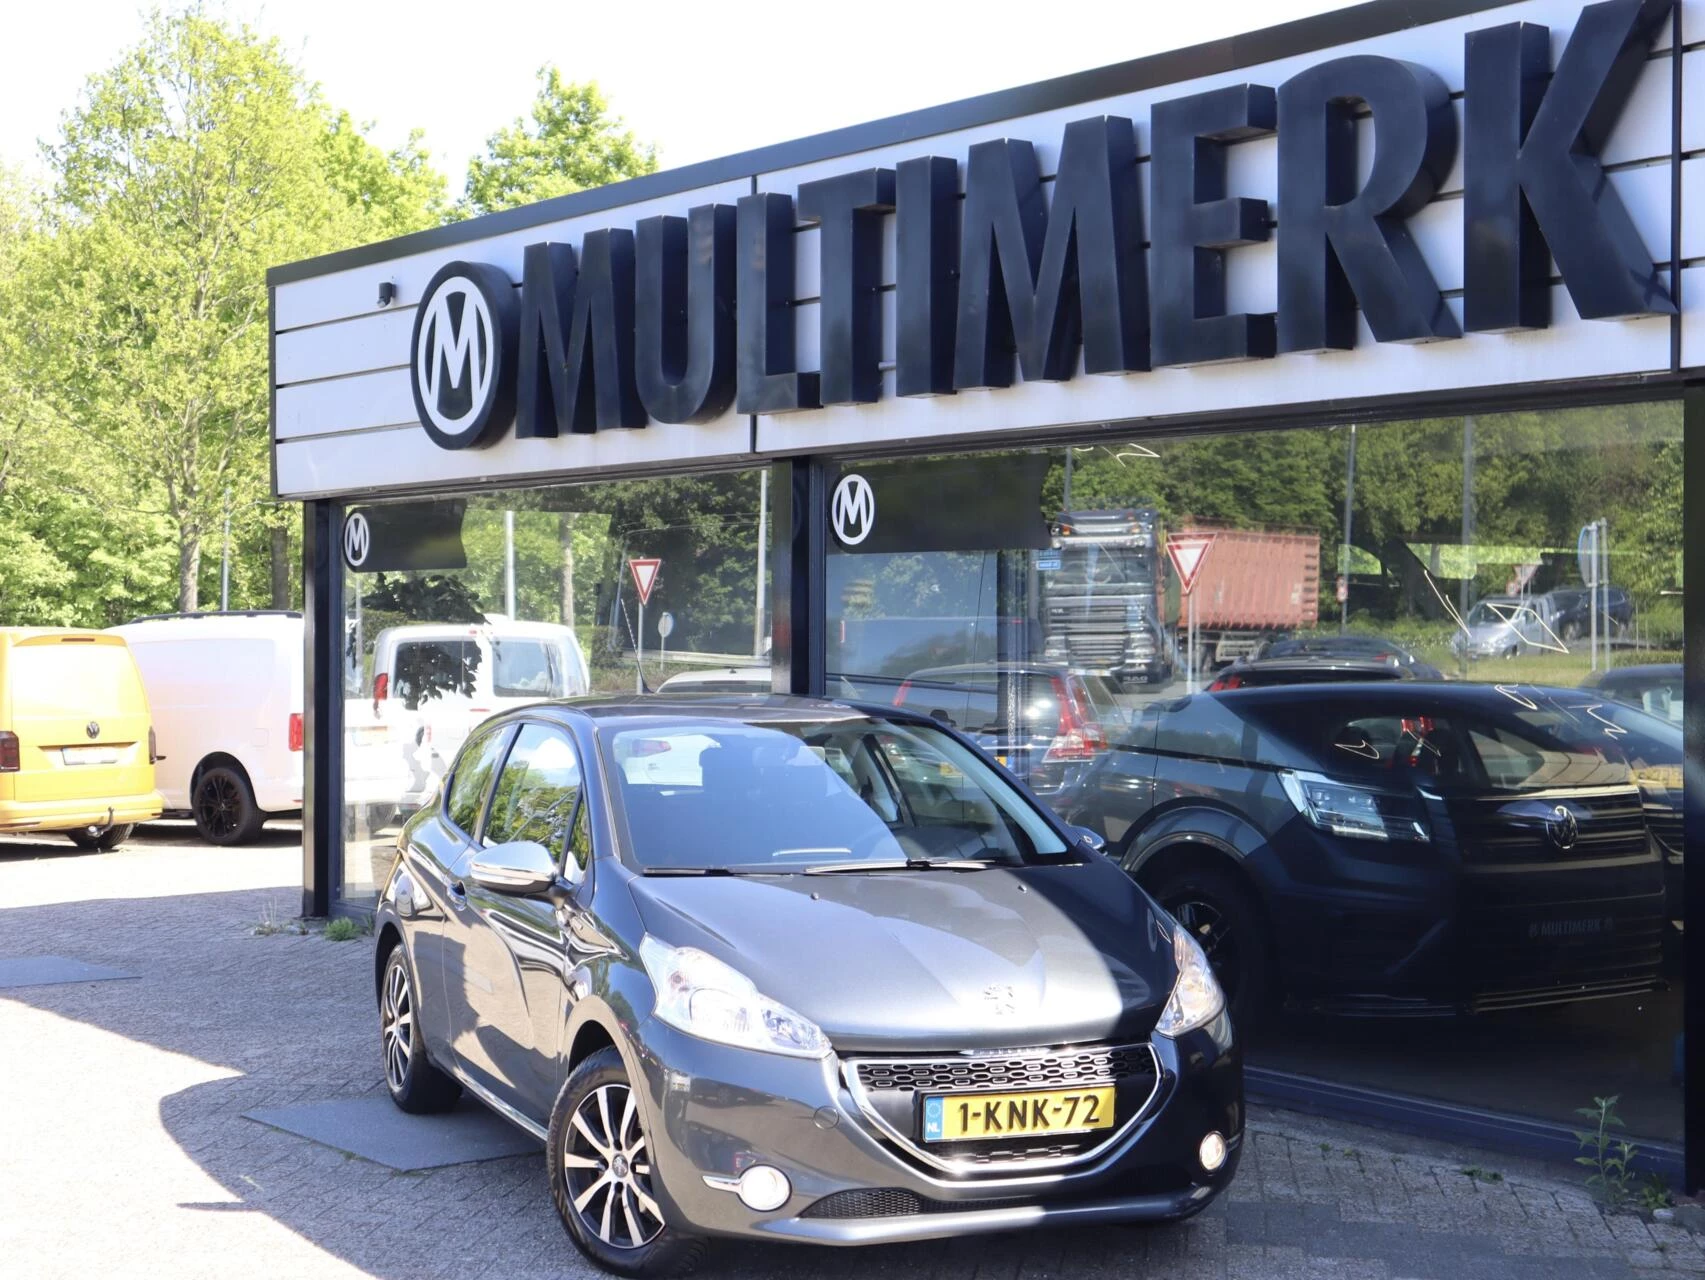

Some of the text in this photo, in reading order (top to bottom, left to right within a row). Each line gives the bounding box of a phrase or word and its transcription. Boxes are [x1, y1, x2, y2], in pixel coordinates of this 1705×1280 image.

[516, 0, 1679, 439] MULTIMERK
[927, 1094, 1100, 1133] NL 1-KNK-72
